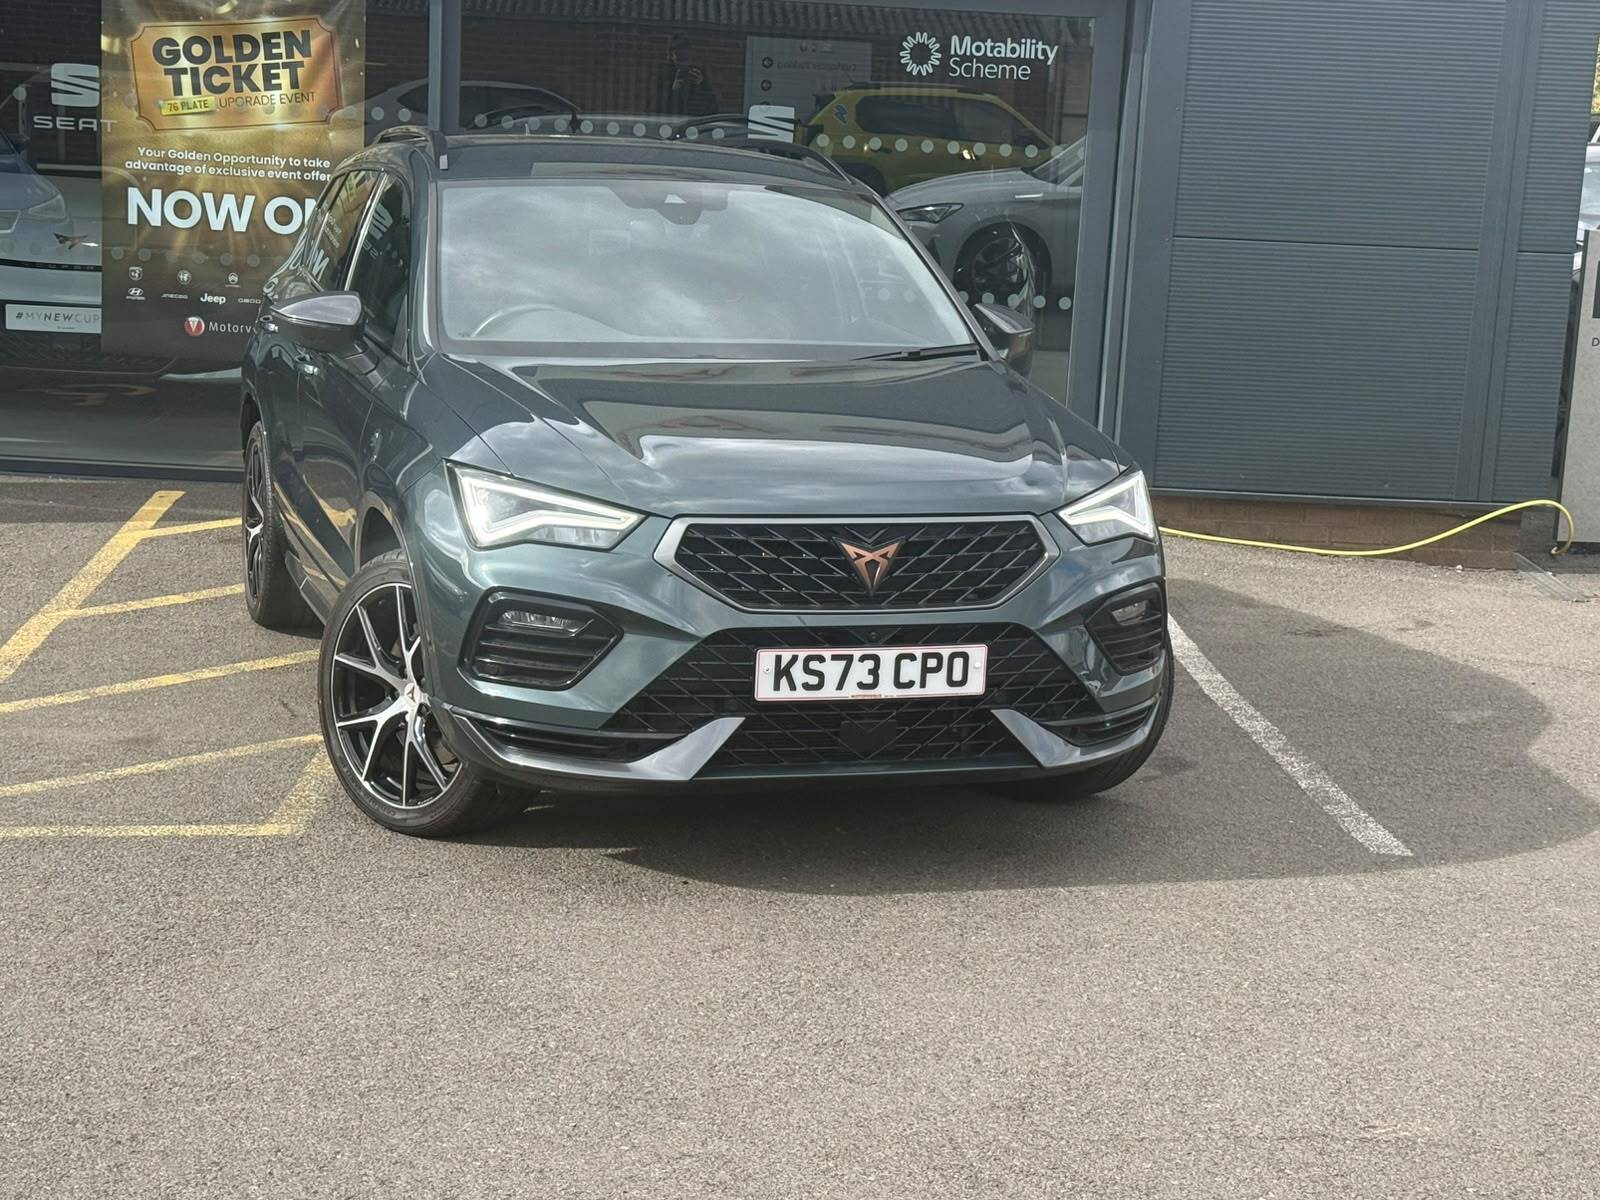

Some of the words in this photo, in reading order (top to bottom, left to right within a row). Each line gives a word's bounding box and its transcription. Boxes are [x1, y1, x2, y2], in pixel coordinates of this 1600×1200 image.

[152, 29, 312, 66] GOLDEN
[950, 34, 1059, 66] Motability
[163, 60, 305, 97] TICKET
[948, 57, 1031, 81] Scheme
[167, 102, 179, 112] 76
[181, 99, 209, 111] PLATE
[218, 94, 277, 109] UPGRADE
[279, 91, 317, 104] EVENT
[33, 115, 118, 133] SEAT
[138, 146, 165, 159] Your
[168, 149, 212, 162] Golden
[213, 152, 287, 168] Opportunity
[288, 156, 300, 168] to
[303, 157, 331, 169] take
[125, 159, 192, 176] advantage
[194, 164, 207, 175] of
[208, 166, 265, 178] exclusive
[267, 170, 301, 181] event
[127, 186, 256, 233] NOW
[200, 292, 226, 304] Jeep
[773, 653, 881, 692] KS73
[892, 651, 970, 690] CPO
